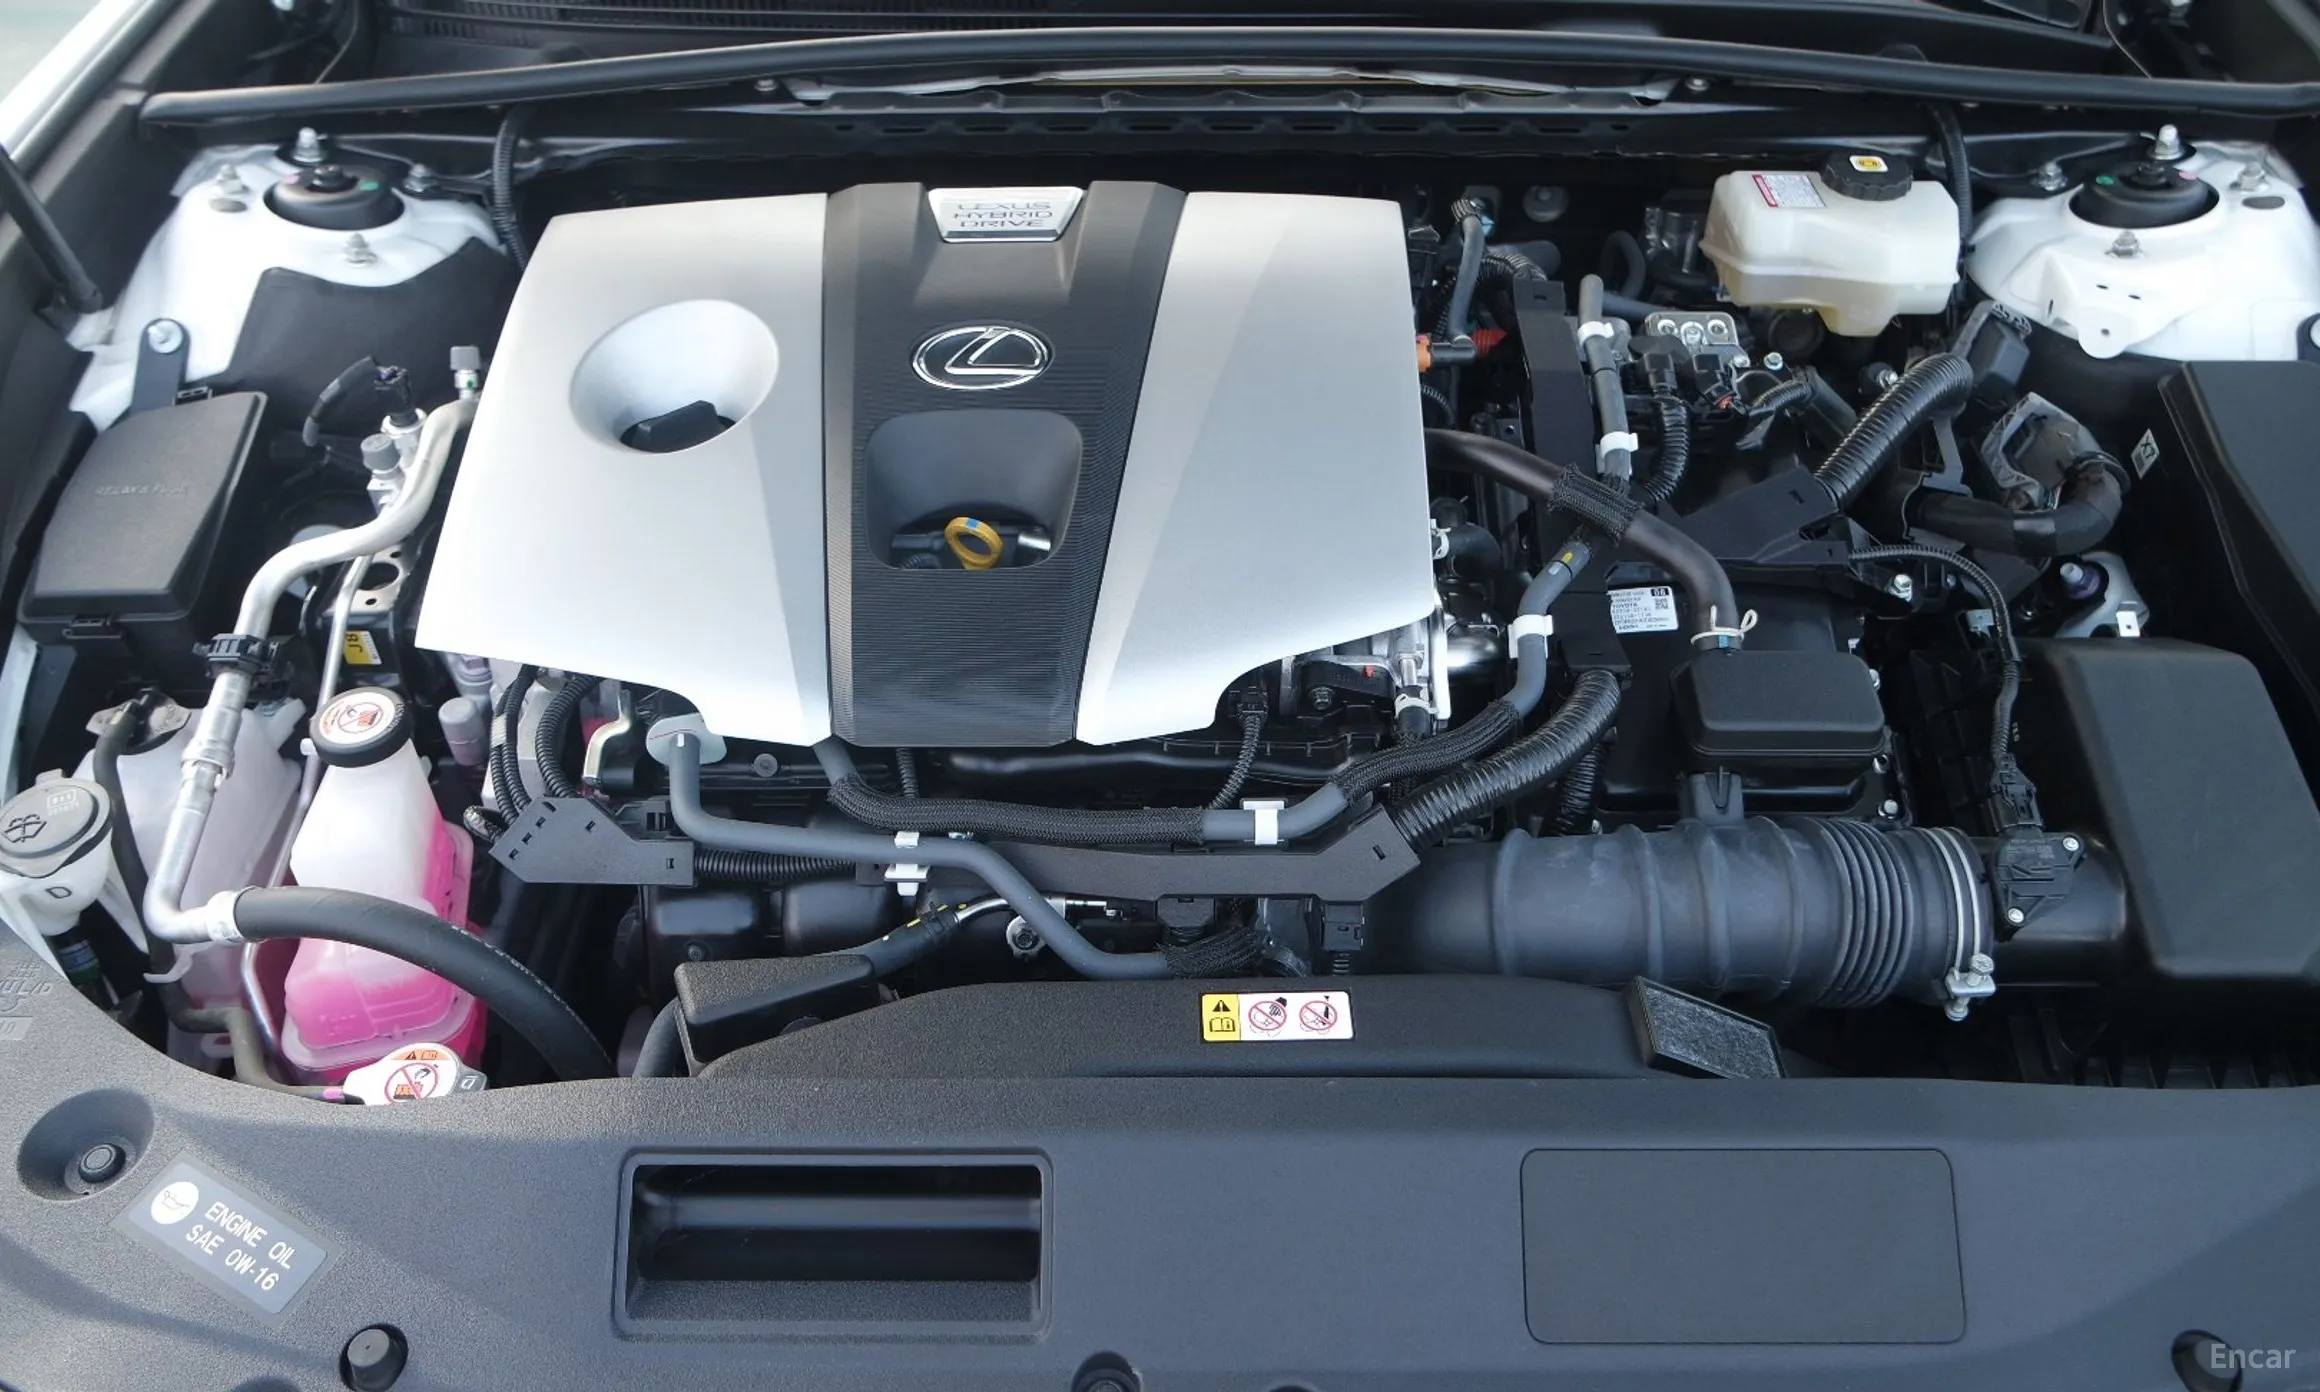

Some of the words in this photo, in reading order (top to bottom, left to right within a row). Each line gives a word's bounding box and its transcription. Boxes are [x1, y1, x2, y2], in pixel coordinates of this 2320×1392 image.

[958, 202, 1051, 210] LEXUS
[954, 210, 1053, 219] HYBRID
[960, 219, 1045, 228] DRIVE
[204, 1201, 268, 1248] ENGINE
[268, 1241, 296, 1270] OIL
[185, 1224, 225, 1256] SAE
[225, 1248, 280, 1291] 0W-16
